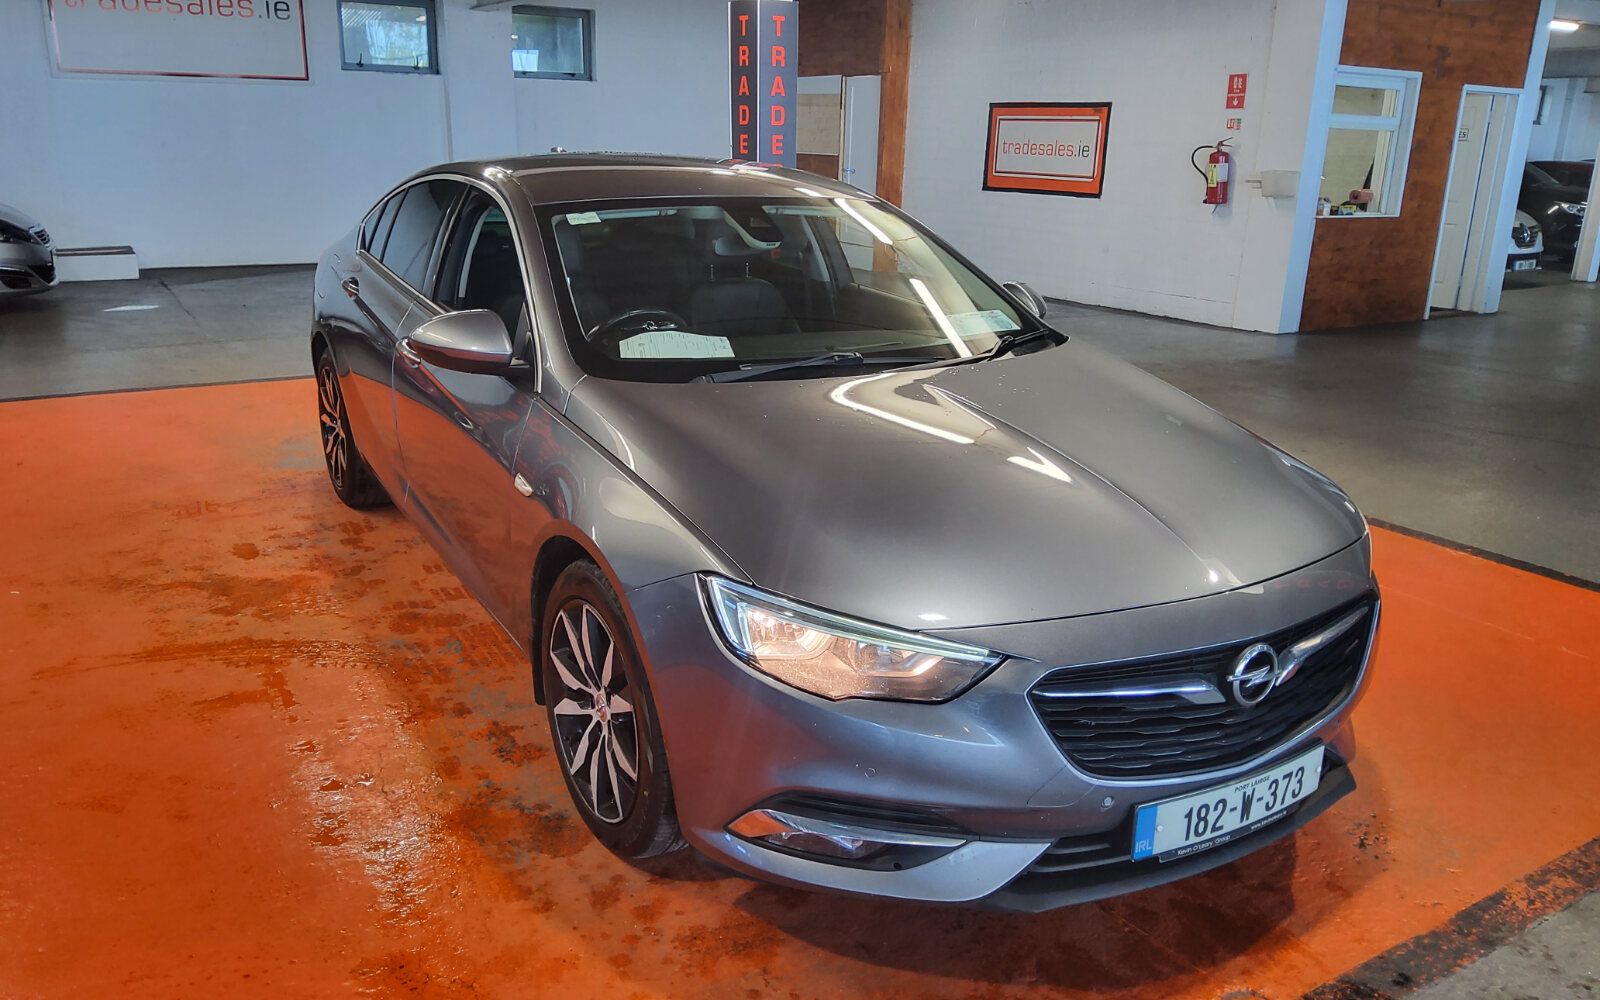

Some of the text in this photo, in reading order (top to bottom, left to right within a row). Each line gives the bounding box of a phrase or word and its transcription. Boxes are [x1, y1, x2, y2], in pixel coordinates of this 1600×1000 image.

[770, 14, 786, 168] TRADE
[1002, 138, 1090, 158] tradesales.ie
[1234, 783, 1250, 793] PORT
[1183, 766, 1305, 841] 182-W-373
[1135, 840, 1153, 853] IRL
[1177, 847, 1193, 856] Kevin
